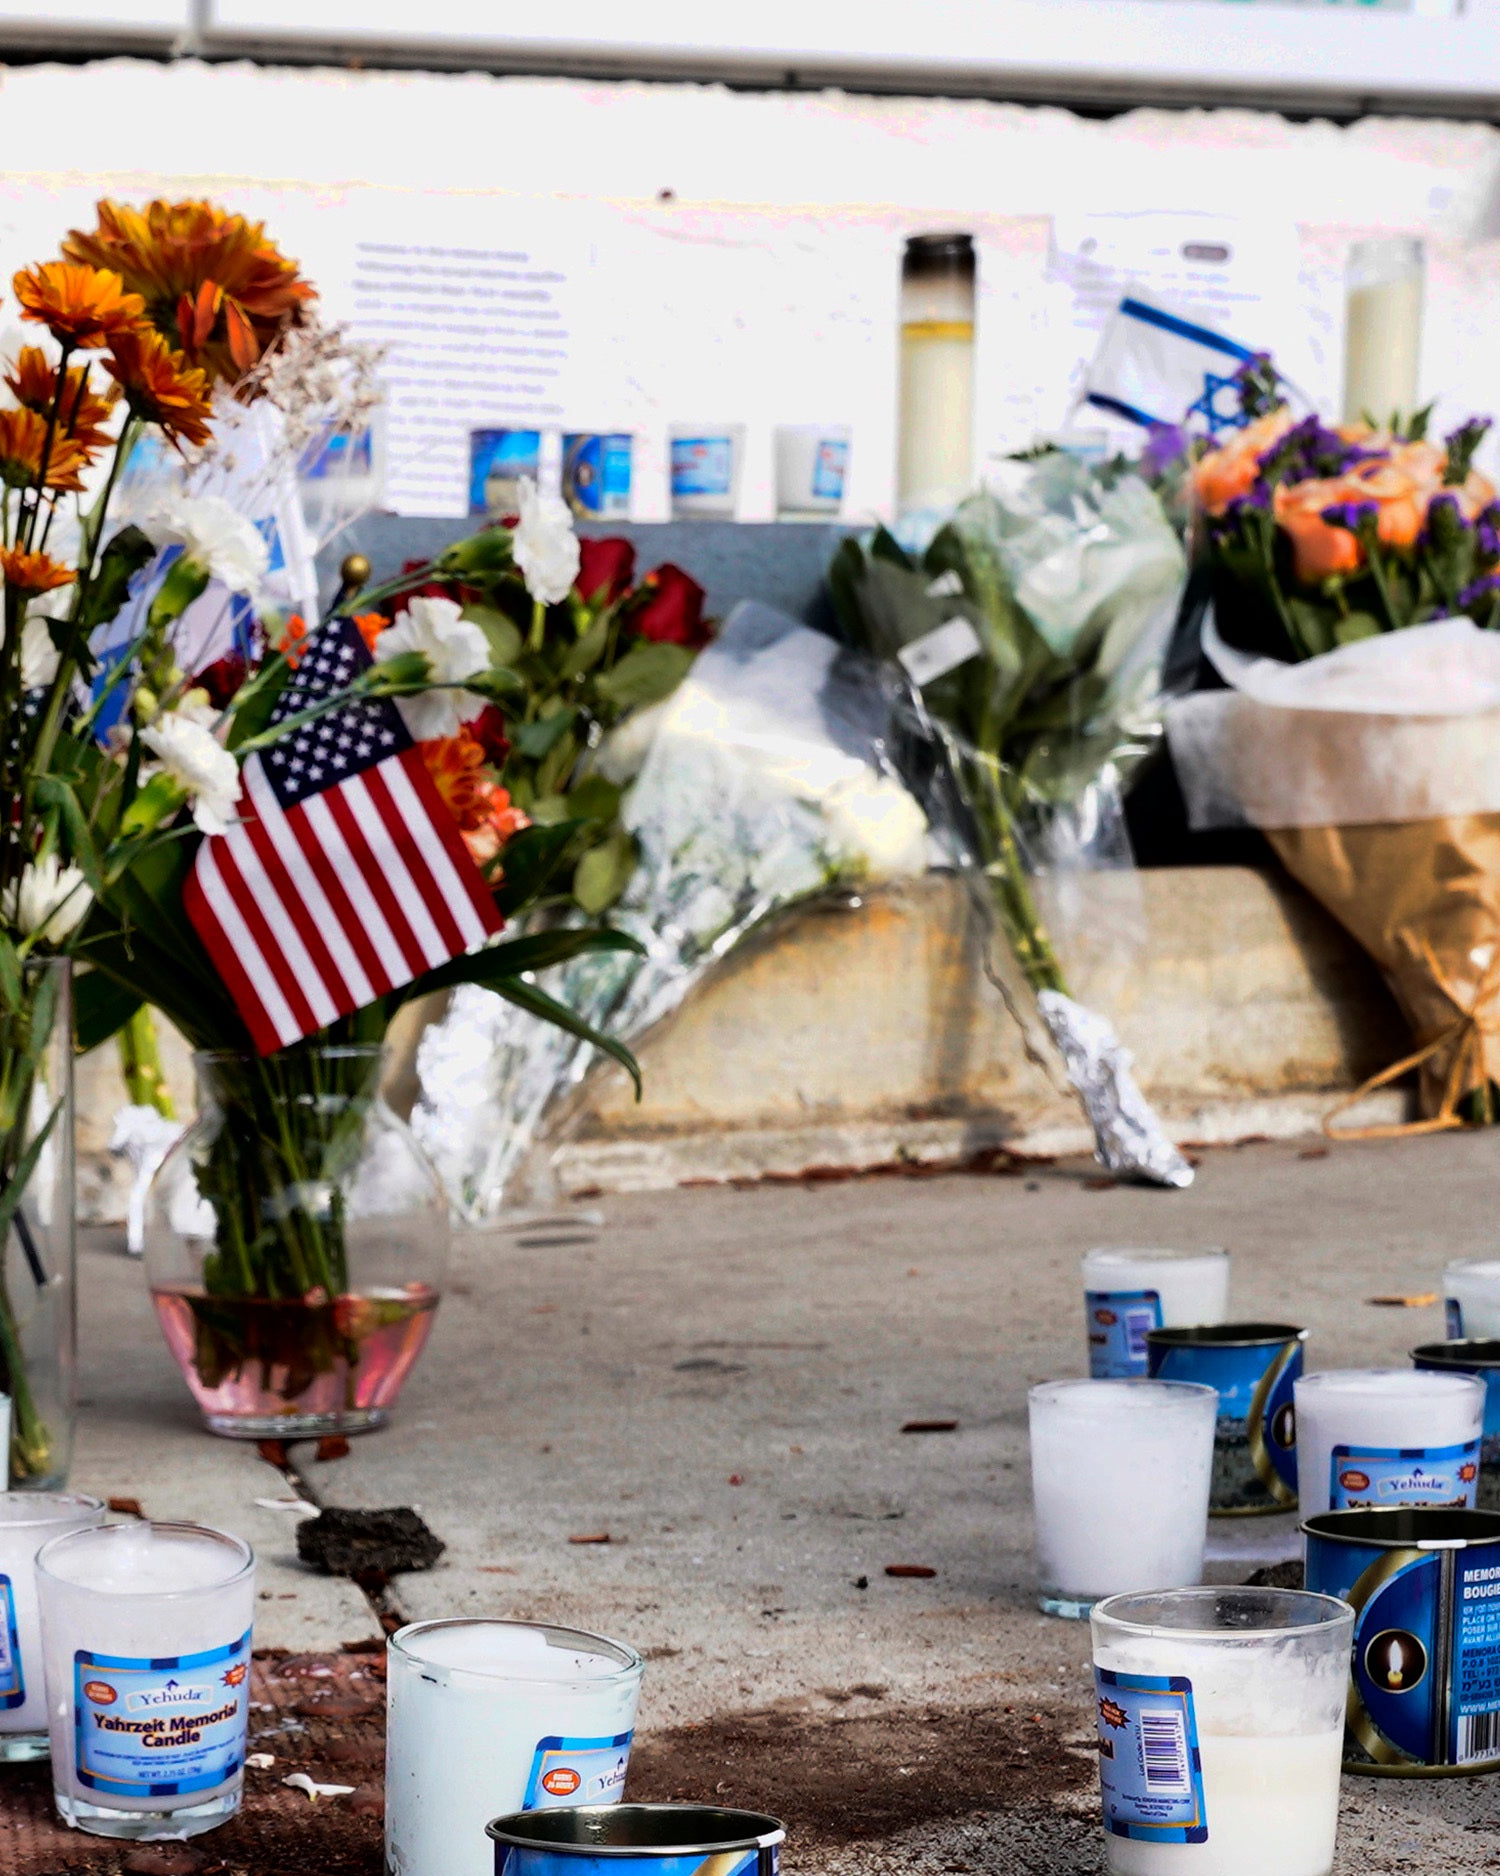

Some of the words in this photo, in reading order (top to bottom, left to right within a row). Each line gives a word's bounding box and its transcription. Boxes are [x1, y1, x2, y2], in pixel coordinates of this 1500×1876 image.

[1389, 1477, 1443, 1491] Yehuda
[139, 1688, 203, 1706] Yehuda
[93, 1712, 166, 1733] Yahrzeit
[170, 1699, 239, 1730] Memorial
[142, 1728, 202, 1749] Candle
